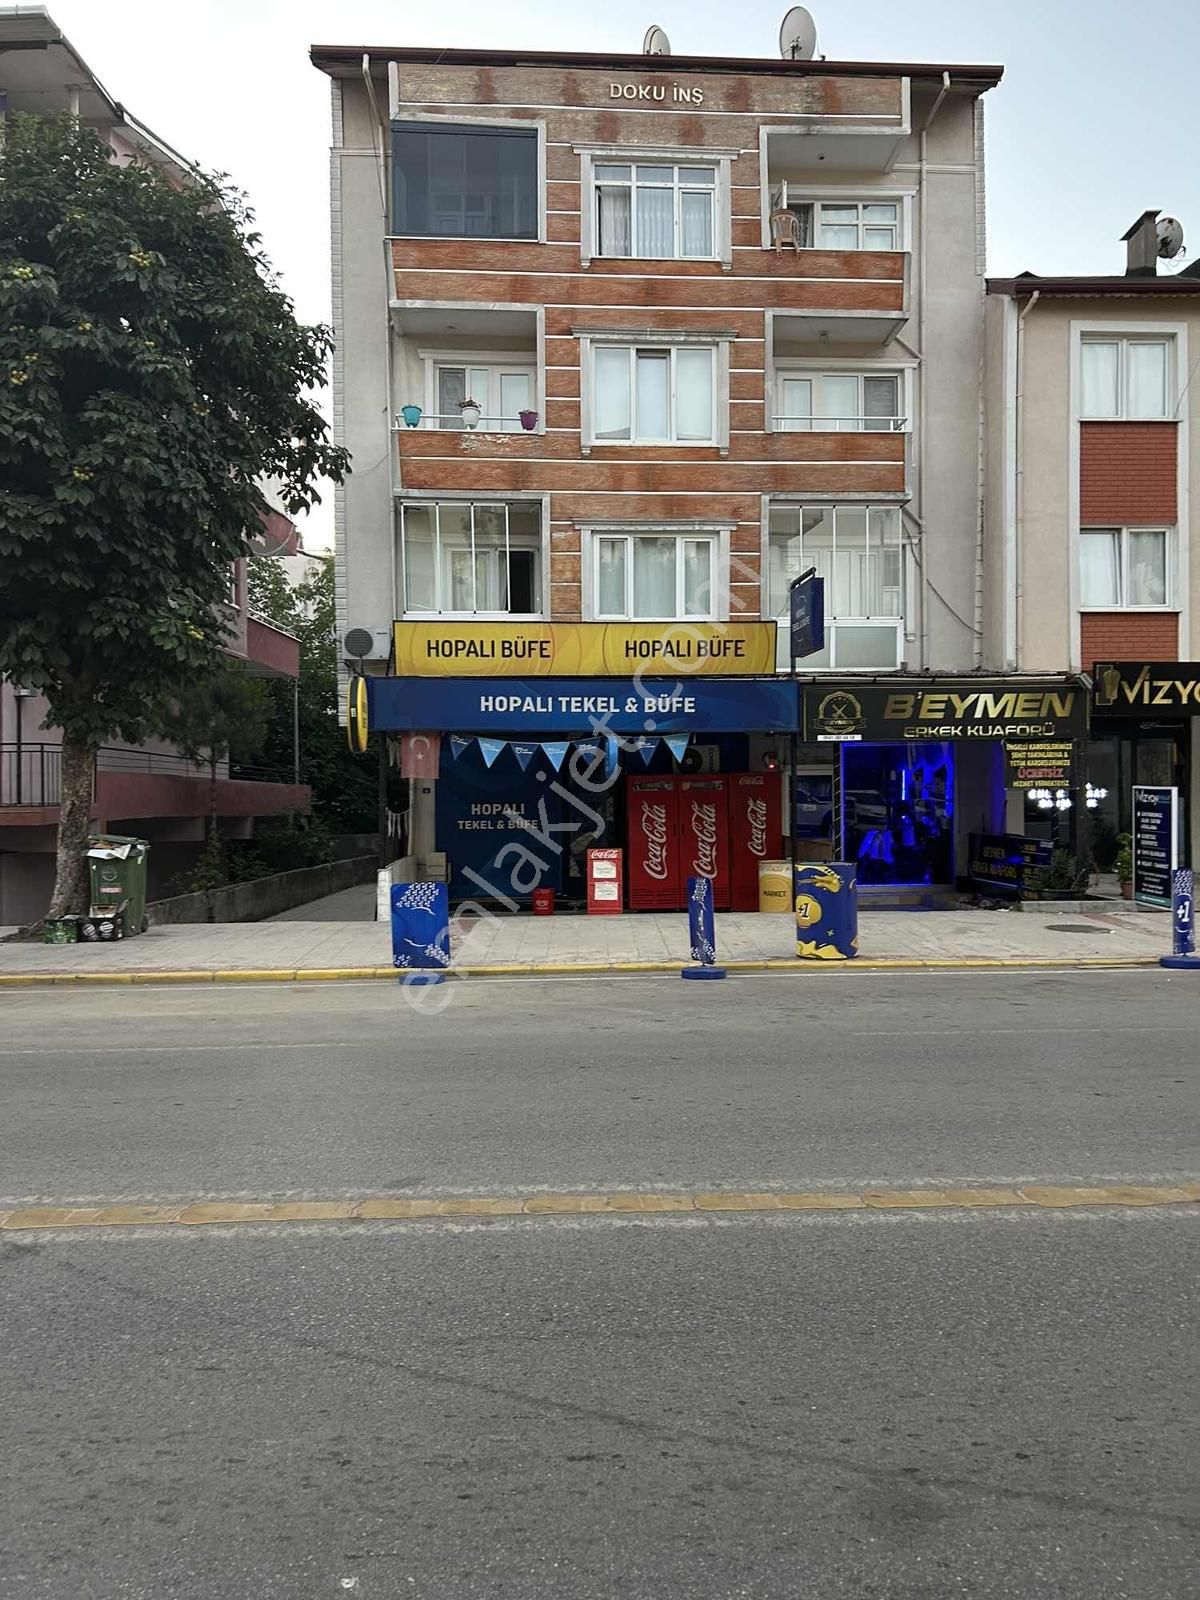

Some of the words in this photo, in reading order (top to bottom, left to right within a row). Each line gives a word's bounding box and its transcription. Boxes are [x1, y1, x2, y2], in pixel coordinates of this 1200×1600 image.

[610, 84, 665, 100] DOKU
[673, 83, 704, 106] İNŞ
[427, 640, 495, 658] HOPALI
[501, 636, 551, 658] BÜFE
[625, 640, 691, 658] HOPALI
[697, 635, 746, 658] BÜFE
[480, 696, 553, 712] HOPALI
[558, 697, 620, 713] TEKEL
[625, 697, 639, 713] &
[644, 693, 696, 713] BÜFE
[904, 725, 962, 737] ERKEK
[967, 721, 1056, 737] KUAFÖRÜ
[471, 803, 525, 816] HOPALI
[457, 820, 494, 830] TEKEL
[497, 820, 505, 830] &
